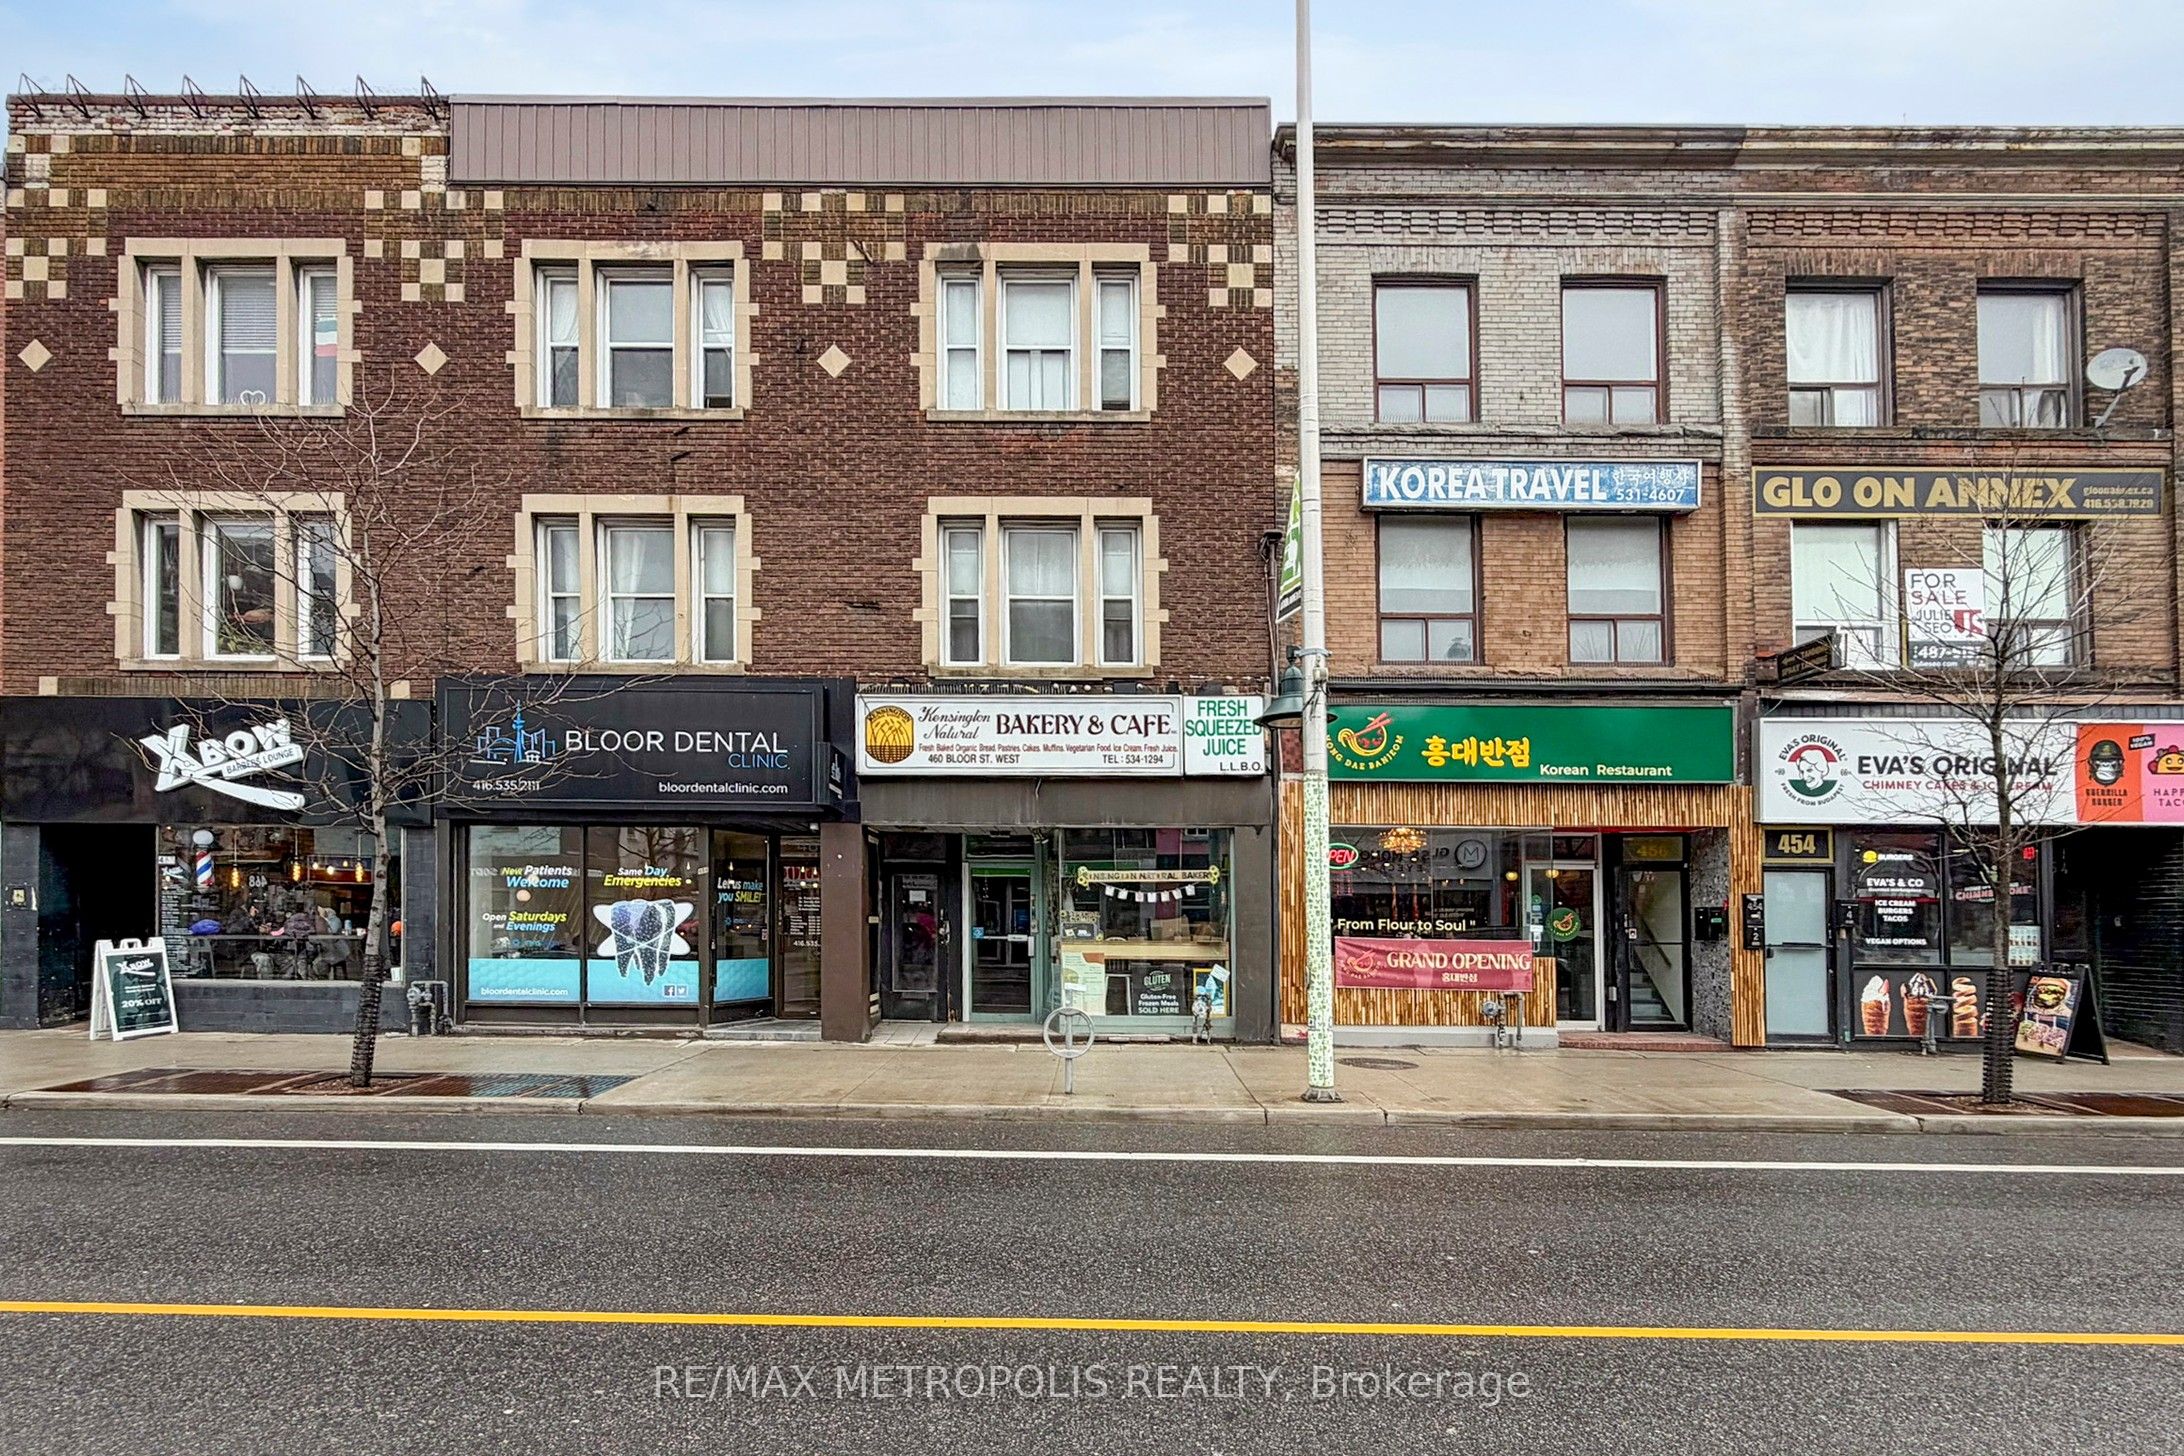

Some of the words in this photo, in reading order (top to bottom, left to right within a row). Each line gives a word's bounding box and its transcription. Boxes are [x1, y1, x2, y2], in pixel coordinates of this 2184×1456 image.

[1615, 488, 1686, 502] 531-4607
[1762, 475, 1843, 508] GLO
[1852, 475, 1916, 508] ON
[1924, 476, 2077, 509] ANNEX
[1911, 573, 1956, 588] FOR
[1911, 590, 1968, 605] SALE
[1915, 609, 1952, 621] JULIE
[1923, 621, 1952, 633] SEO
[1197, 700, 1248, 717] FRESH
[918, 705, 991, 728] Kensington
[995, 714, 1085, 735] BAKERY
[1087, 713, 1104, 735] &
[1110, 714, 1171, 738] CAFE
[1185, 719, 1263, 737] SQUEEZED
[923, 724, 980, 740] Natural
[565, 730, 665, 752] BLOOR
[674, 731, 789, 754] DENTAL
[1203, 738, 1247, 756] JUICE
[1800, 733, 1846, 762] ORIGINAL
[918, 743, 935, 752] Fresh
[936, 743, 954, 752] Baked
[955, 743, 977, 754] Organic
[1066, 743, 1095, 754] Vegetarian
[1113, 743, 1122, 752] Ice
[1144, 743, 1160, 752] Fresh
[1344, 759, 1366, 771] DAE
[1367, 734, 1405, 770] BANJEOM
[1421, 735, 1531, 768] 홍대반점
[262, 749, 295, 765] LOUNGE
[928, 754, 944, 764] 460
[945, 754, 977, 764] BLOOR
[980, 754, 993, 764] ST.
[996, 754, 1021, 764] WEST
[1125, 754, 1164, 764] 534-1294
[1219, 761, 1264, 772] L.L.B.O.
[1539, 764, 1590, 777] Korean
[1596, 764, 1673, 777] Restaurant
[1857, 755, 1925, 776] EVA'S
[1932, 755, 2058, 777] ORIGNAL
[658, 781, 789, 795] bloordentalclinic.com
[1862, 780, 1922, 791] CHIMNEY
[1925, 780, 1967, 791] CAKES
[1970, 780, 1981, 791] &
[2010, 780, 2054, 791] REAM
[1780, 782, 1797, 801] FRESH
[1796, 798, 1817, 807] FROM
[1817, 783, 1846, 807] BUDAPEST
[2085, 788, 2128, 797] GUERRILLA
[2091, 798, 2123, 807] BURGER
[1777, 834, 1816, 854] 454
[1327, 849, 1355, 865] PEN
[1877, 853, 1914, 861] BURGERS
[501, 866, 524, 877] New
[524, 865, 573, 877] Patients
[617, 867, 643, 877] Same
[645, 866, 668, 878] Day
[506, 875, 570, 889] Welcome
[603, 874, 683, 888] Emergencies
[742, 880, 764, 892] make
[1866, 878, 1894, 888] EVA'S
[1896, 878, 1907, 888] &
[1908, 878, 1924, 888] CO
[717, 893, 735, 904] you
[1954, 889, 1994, 901] CHIMNE
[1875, 900, 1890, 908] ICE
[1891, 900, 1917, 908] CREAM
[482, 912, 507, 923] Open
[508, 911, 567, 923] Saturdays
[1846, 910, 1853, 919] 4
[1877, 907, 1914, 915] BURGERS
[1337, 918, 1375, 931] From
[1378, 918, 1415, 931] Flour
[1418, 919, 1433, 931] to
[1435, 919, 1467, 931] Soul
[1882, 915, 1909, 923] TACOS
[506, 922, 556, 933] Evenings
[1752, 932, 1760, 941] 2
[1865, 938, 1892, 946] VEGAN
[1892, 938, 1927, 946] OPTIONS
[1386, 951, 1448, 969] GRAND
[1451, 952, 1532, 971] OPENING
[1143, 974, 1172, 987] GLUTEN
[480, 987, 569, 997] bloordentalclinic.com
[1139, 993, 1177, 1001] Gluten-Free
[121, 999, 145, 1008] 20%
[144, 997, 163, 1006] OFF
[1137, 1006, 1159, 1014] SOLD
[1159, 1006, 1180, 1014] HERE
